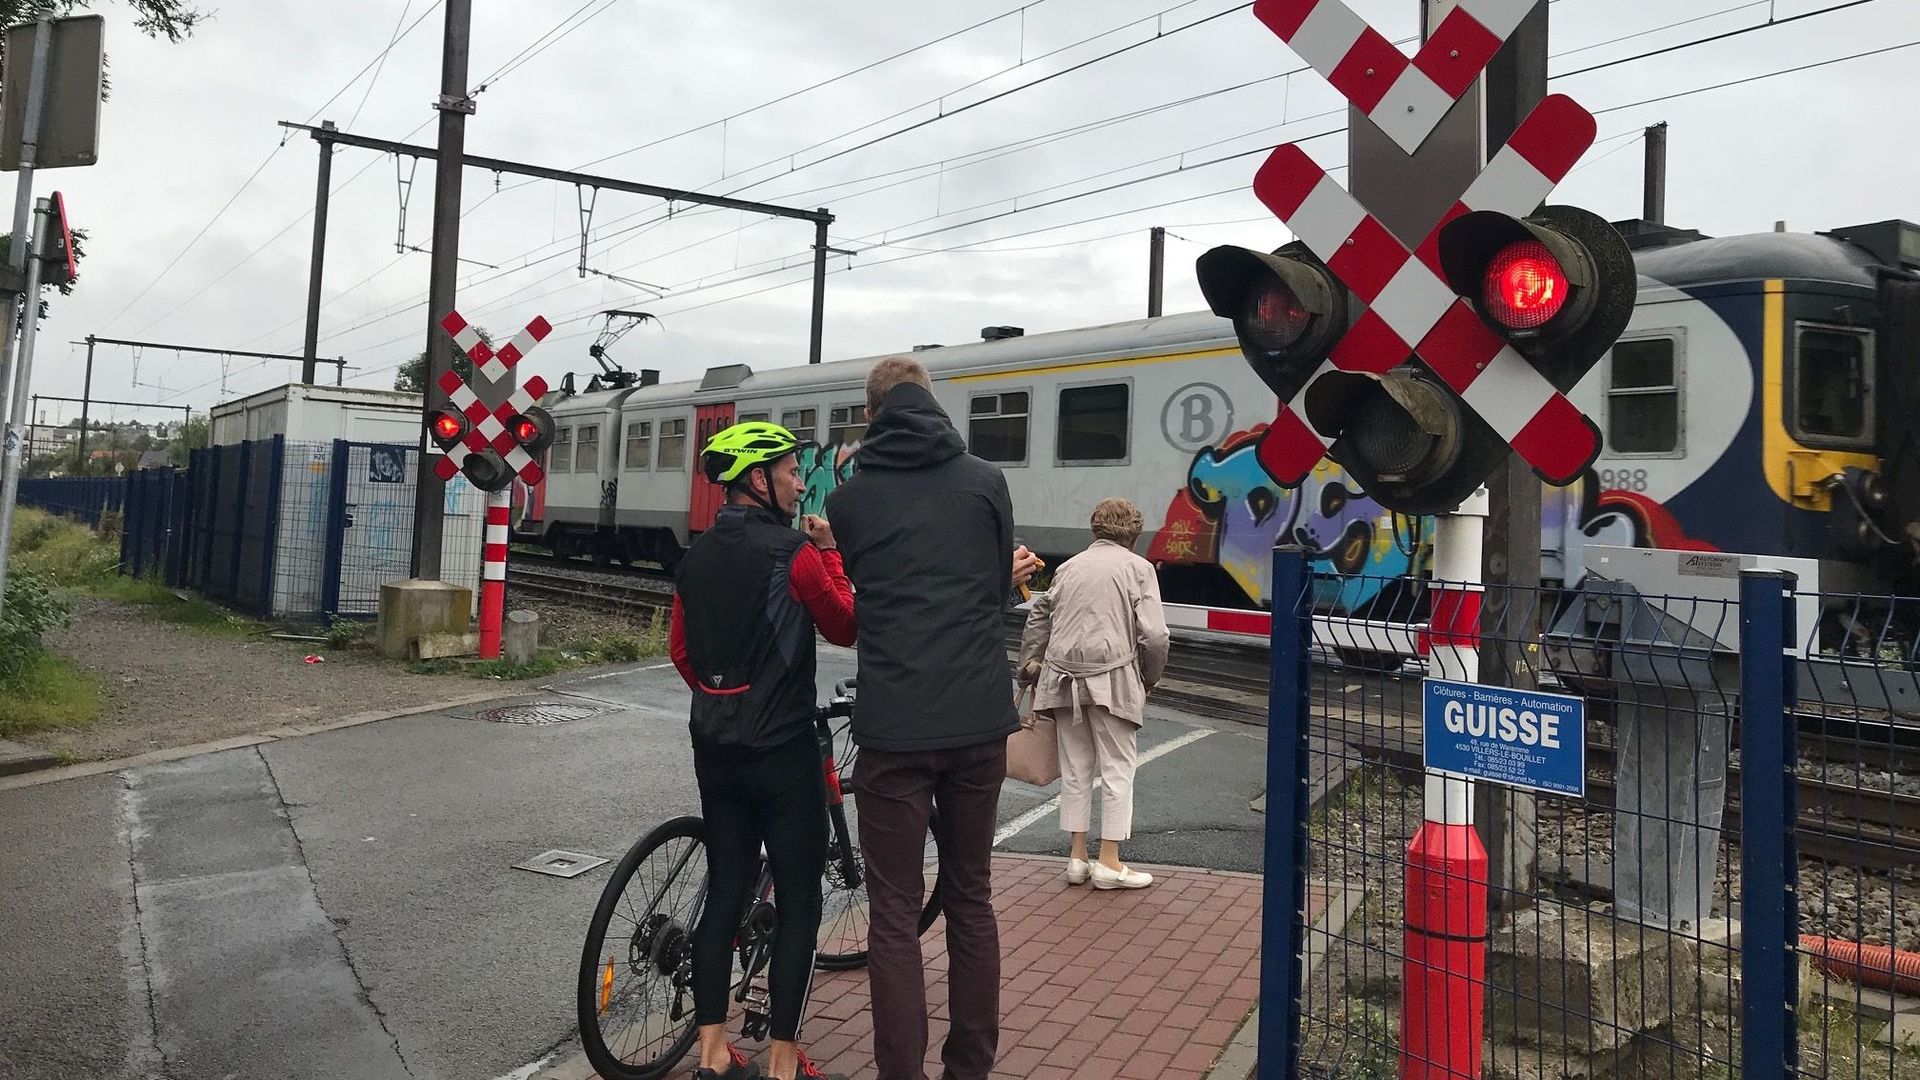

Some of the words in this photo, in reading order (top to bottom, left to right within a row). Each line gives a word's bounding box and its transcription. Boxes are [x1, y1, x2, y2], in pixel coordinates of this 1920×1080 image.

[1179, 393, 1214, 443] B
[1433, 685, 1466, 699] Clôtures
[1473, 690, 1513, 705] Barrières
[1520, 697, 1573, 713] Automation
[1444, 700, 1560, 749] GUISSE
[1471, 744, 1546, 764] VILLERS-LE-BOUILLET
[1542, 780, 1552, 788] ISO
